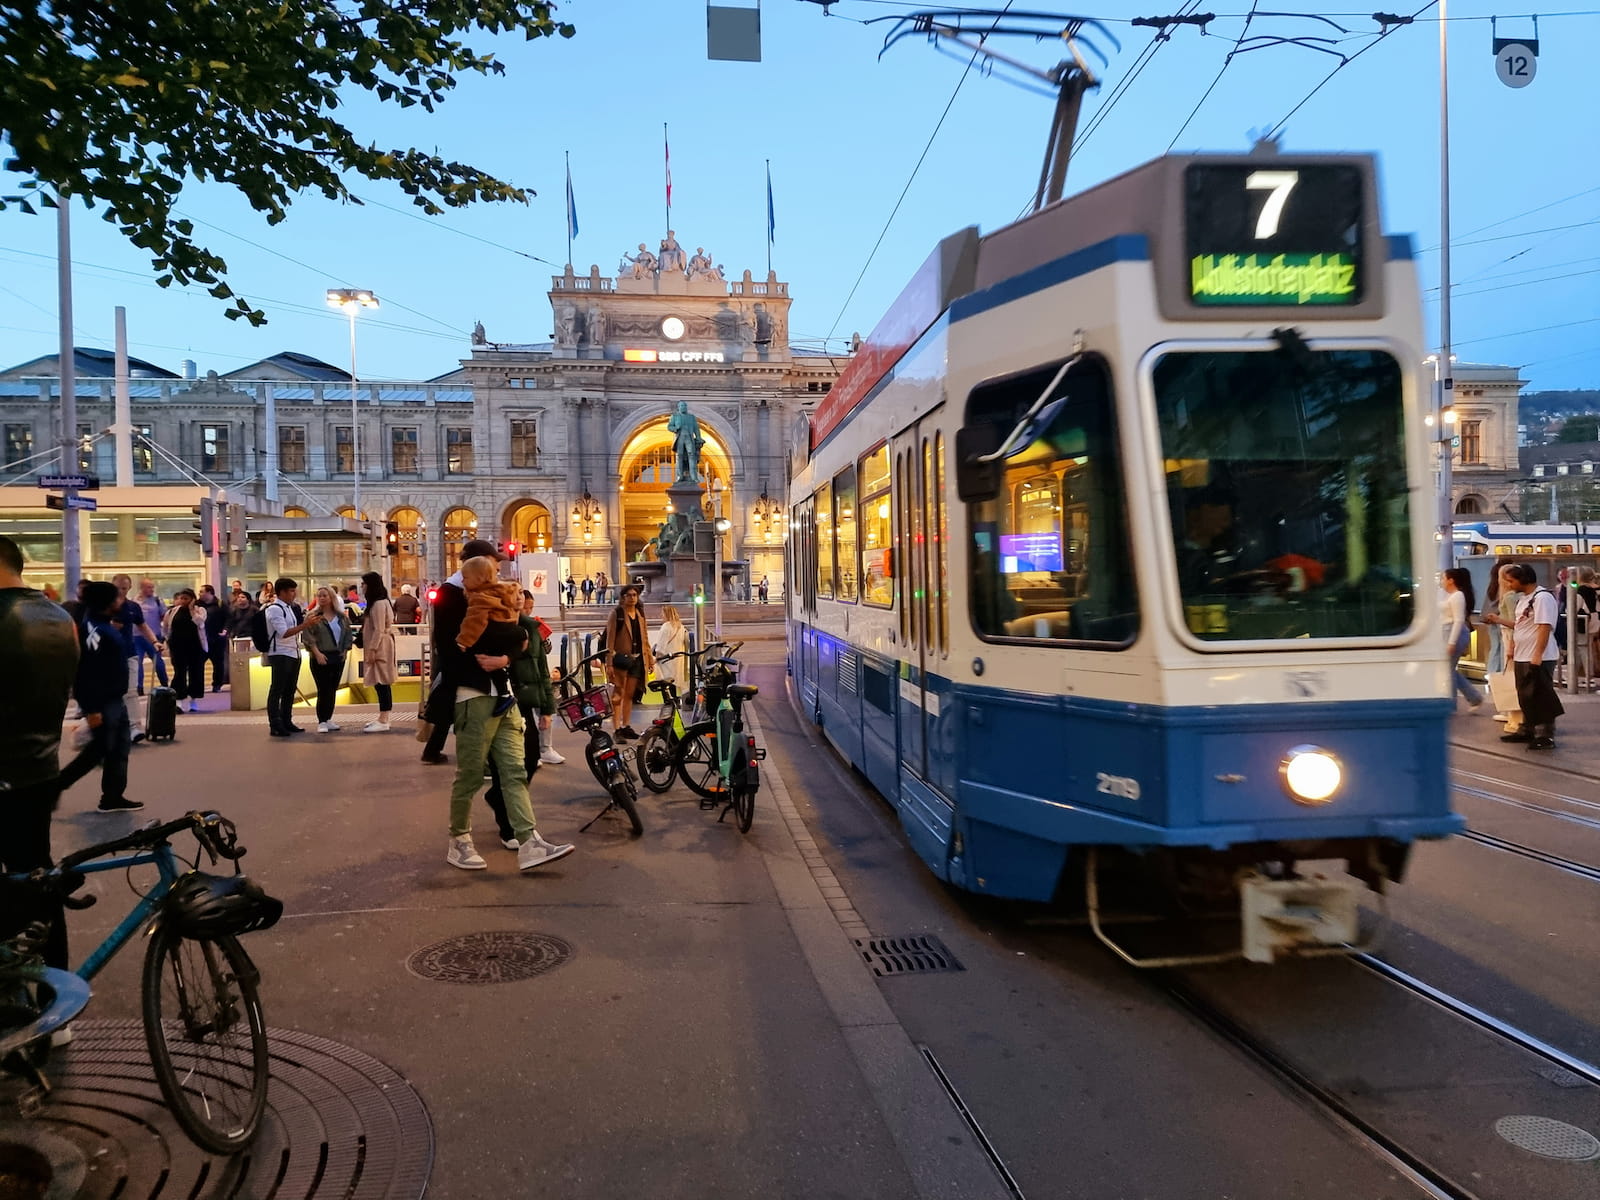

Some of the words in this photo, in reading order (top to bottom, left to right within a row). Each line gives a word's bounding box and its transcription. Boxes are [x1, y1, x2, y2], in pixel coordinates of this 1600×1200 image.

[1504, 56, 1528, 76] 12
[1245, 170, 1299, 239] 7
[682, 352, 702, 361] CFF
[703, 352, 724, 363] FFS
